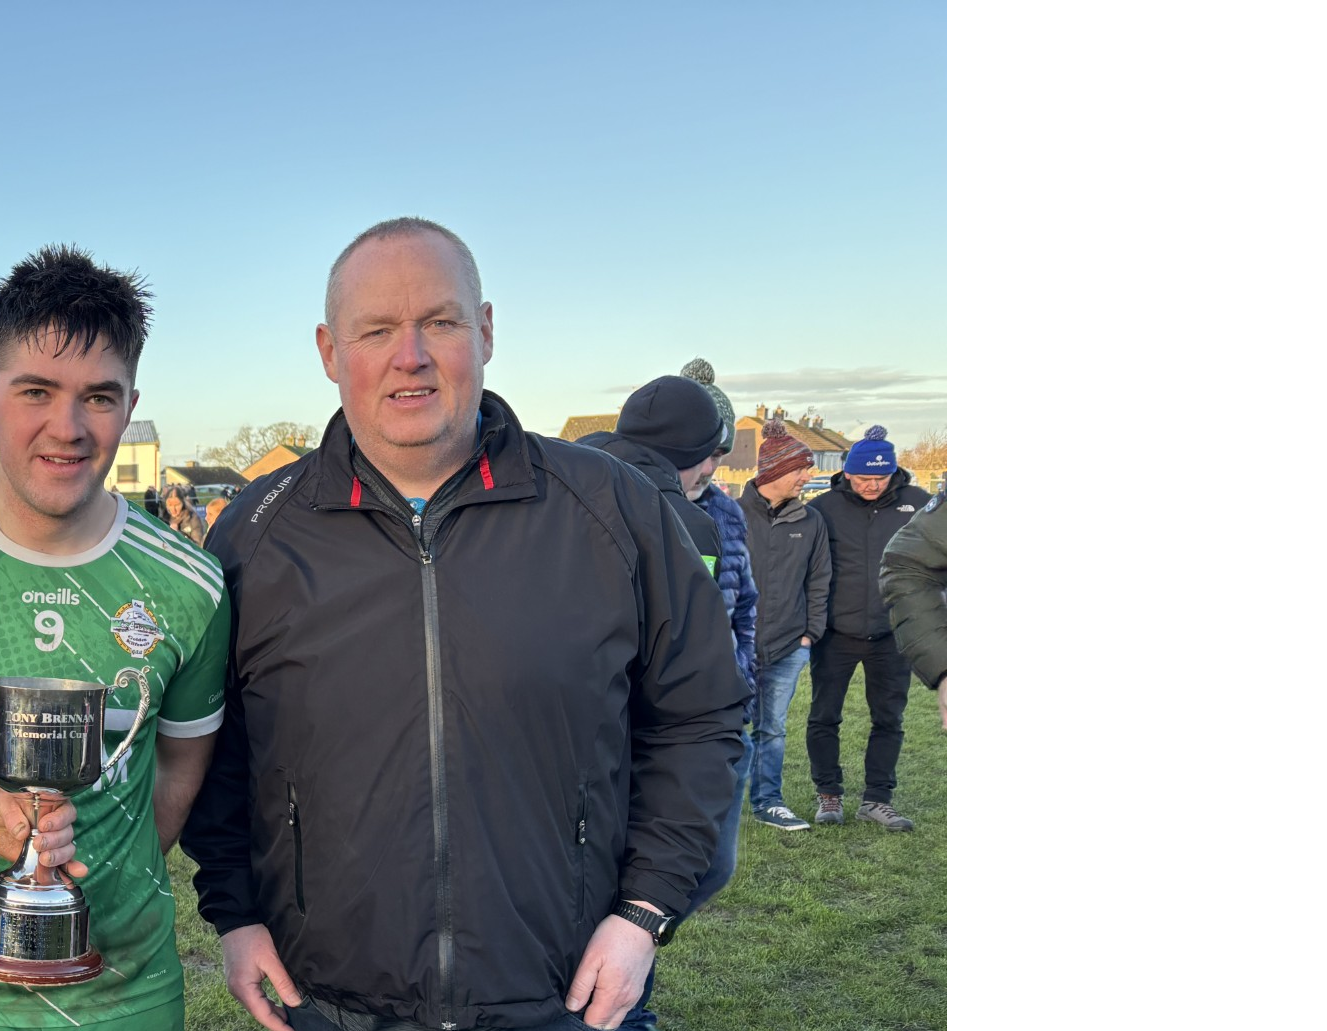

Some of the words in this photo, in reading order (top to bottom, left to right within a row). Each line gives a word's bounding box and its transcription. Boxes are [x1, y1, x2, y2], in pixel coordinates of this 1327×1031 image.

[250, 476, 292, 523] PROQUIP
[34, 609, 65, 652] 9
[5, 710, 38, 723] TONY
[41, 712, 95, 724] BRENNAN
[12, 728, 67, 739] Memorial
